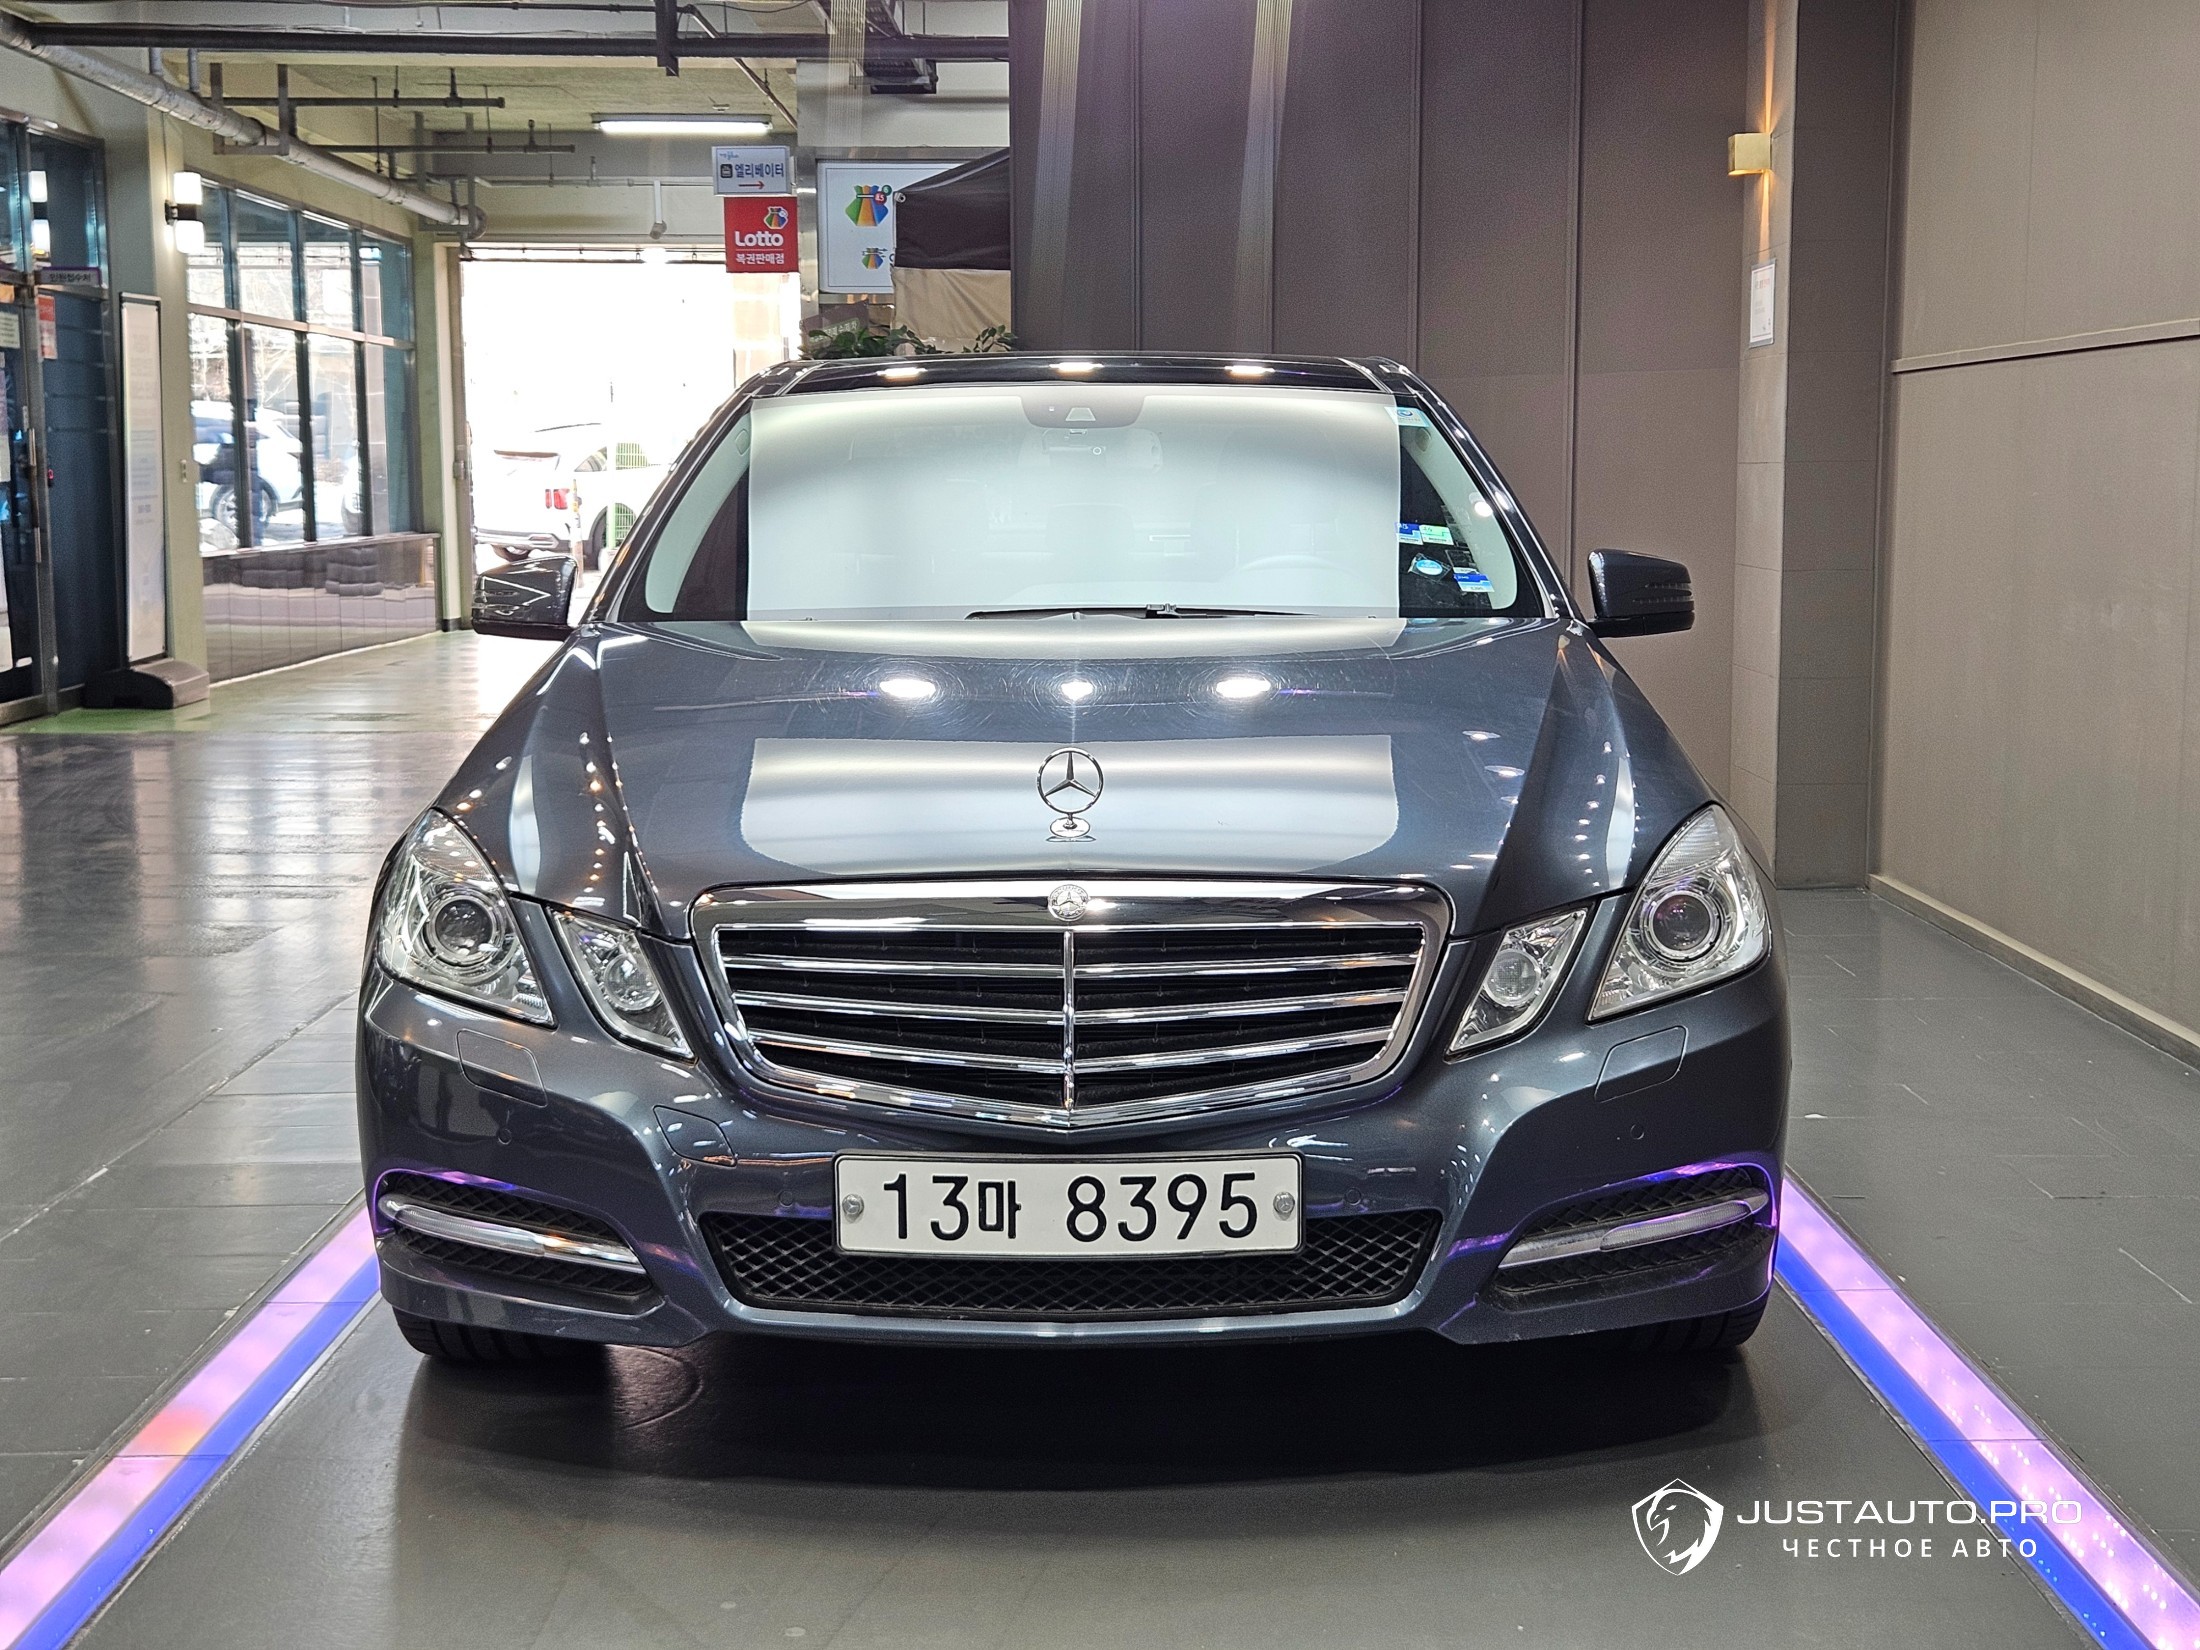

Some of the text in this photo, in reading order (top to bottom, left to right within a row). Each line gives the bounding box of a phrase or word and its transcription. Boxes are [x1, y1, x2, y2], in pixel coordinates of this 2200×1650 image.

[734, 162, 784, 178] 엘리베이터
[734, 231, 784, 247] Lotto
[736, 253, 785, 265] 복권판매점
[883, 1172, 1258, 1242] 13마 8395
